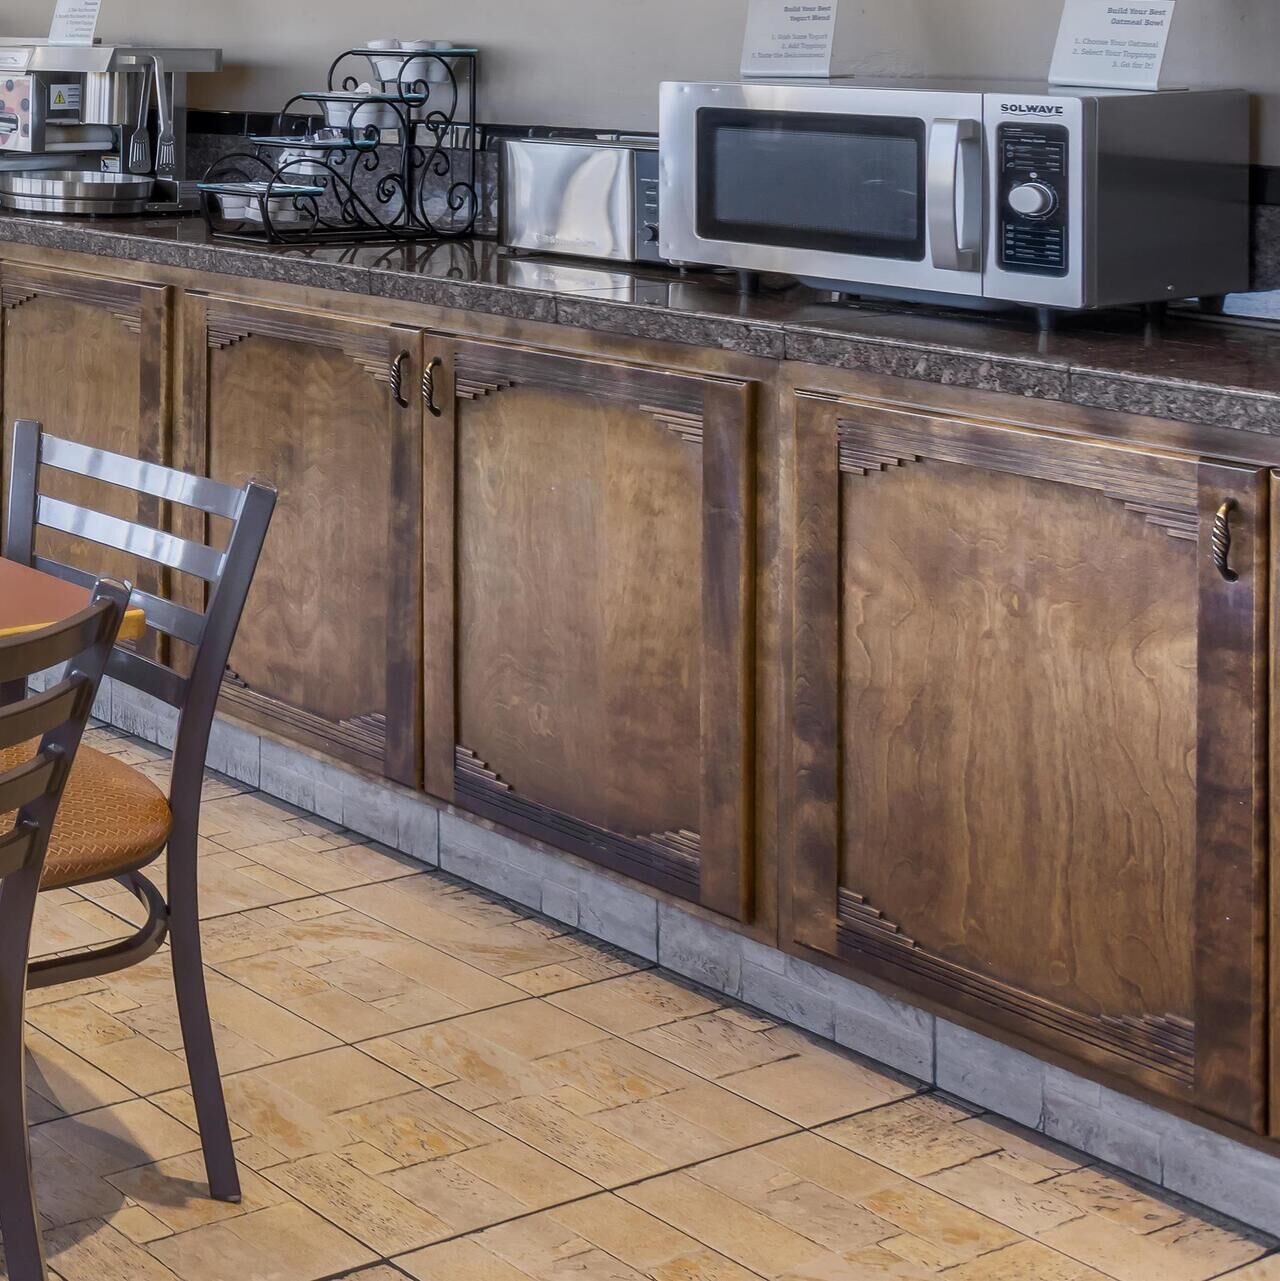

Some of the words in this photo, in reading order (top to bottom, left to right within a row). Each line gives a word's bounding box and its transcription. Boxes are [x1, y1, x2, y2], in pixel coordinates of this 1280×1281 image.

[1149, 8, 1167, 16] Best
[1081, 48, 1104, 56] Select
[1123, 50, 1157, 59] Toppings
[1000, 103, 1064, 114] SOLWAVE
